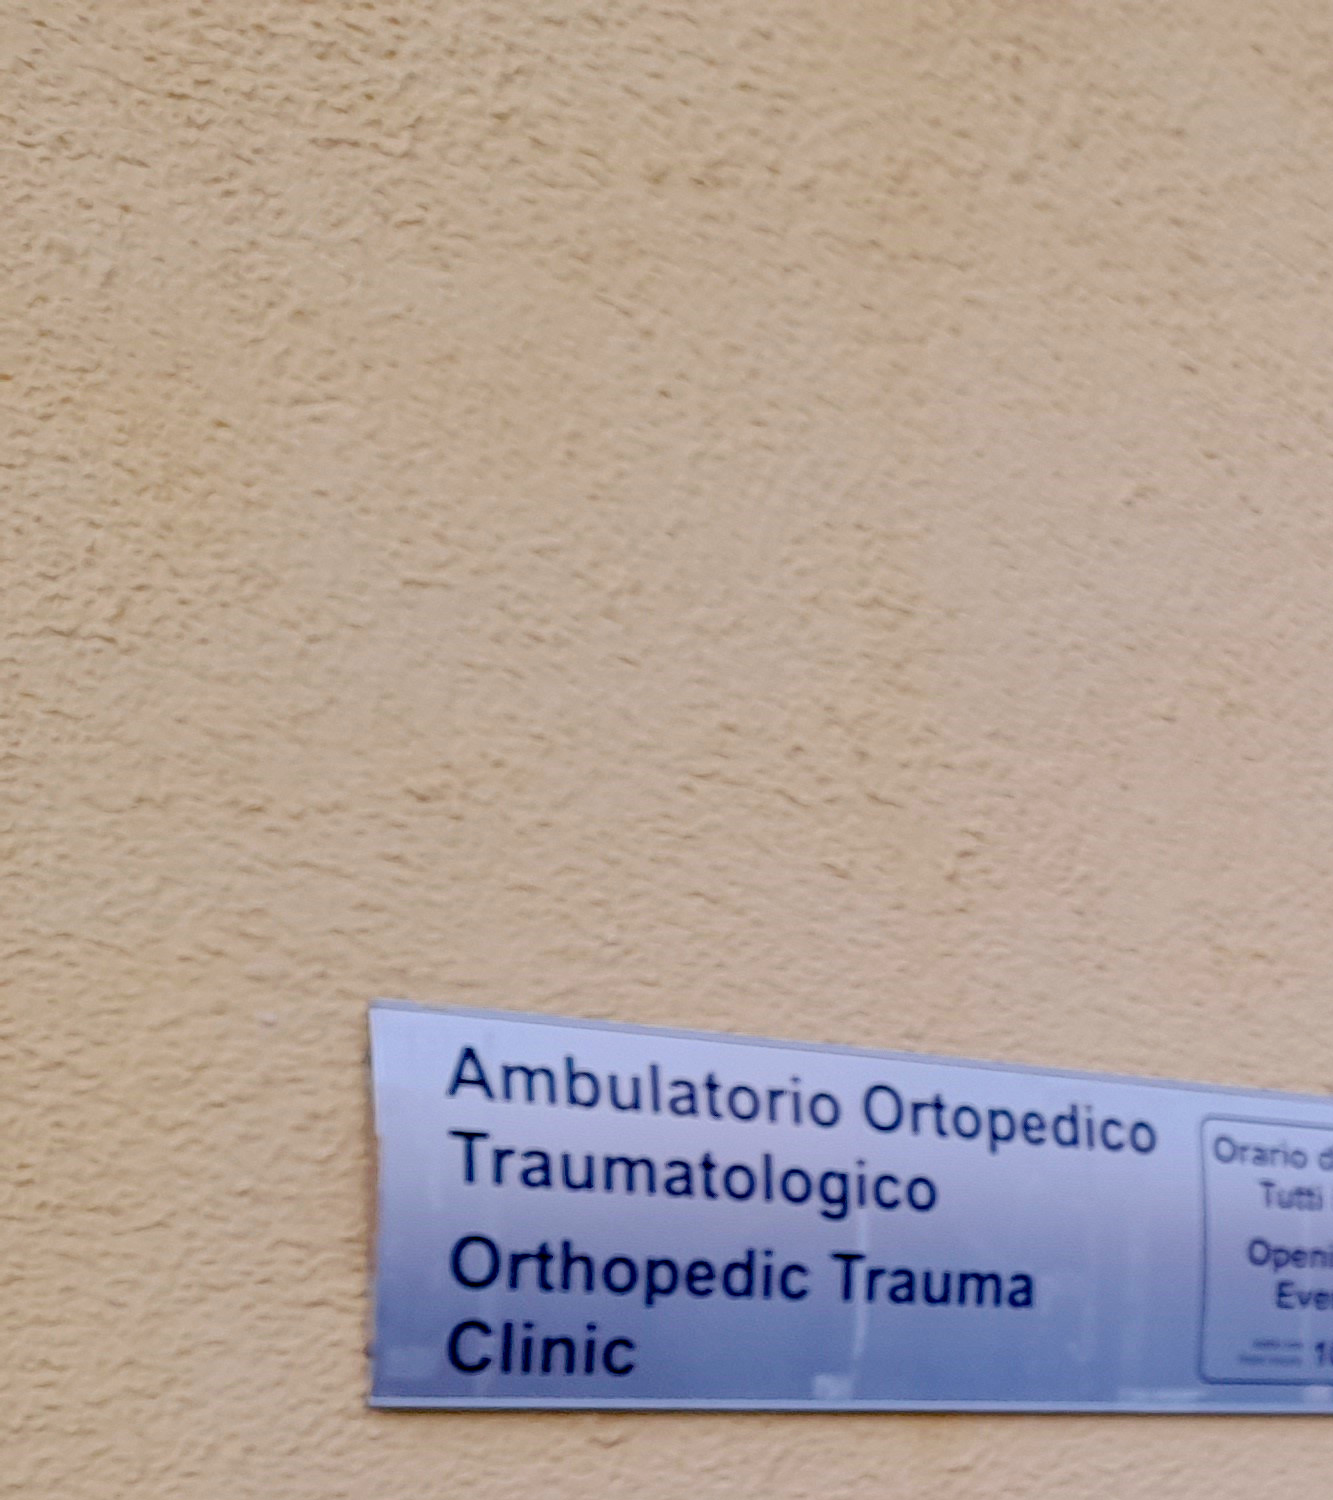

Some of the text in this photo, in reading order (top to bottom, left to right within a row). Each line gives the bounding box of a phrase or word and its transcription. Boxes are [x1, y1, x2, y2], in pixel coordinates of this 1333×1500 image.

[448, 1046, 1158, 1155] Ambulatorio Ortopedico
[449, 1131, 938, 1219] Traumatologico
[1214, 1136, 1308, 1170] Orario
[1259, 1179, 1323, 1211] Tutti
[450, 1235, 1034, 1309] Orthopedic Trauma
[447, 1319, 637, 1377] Clinic
